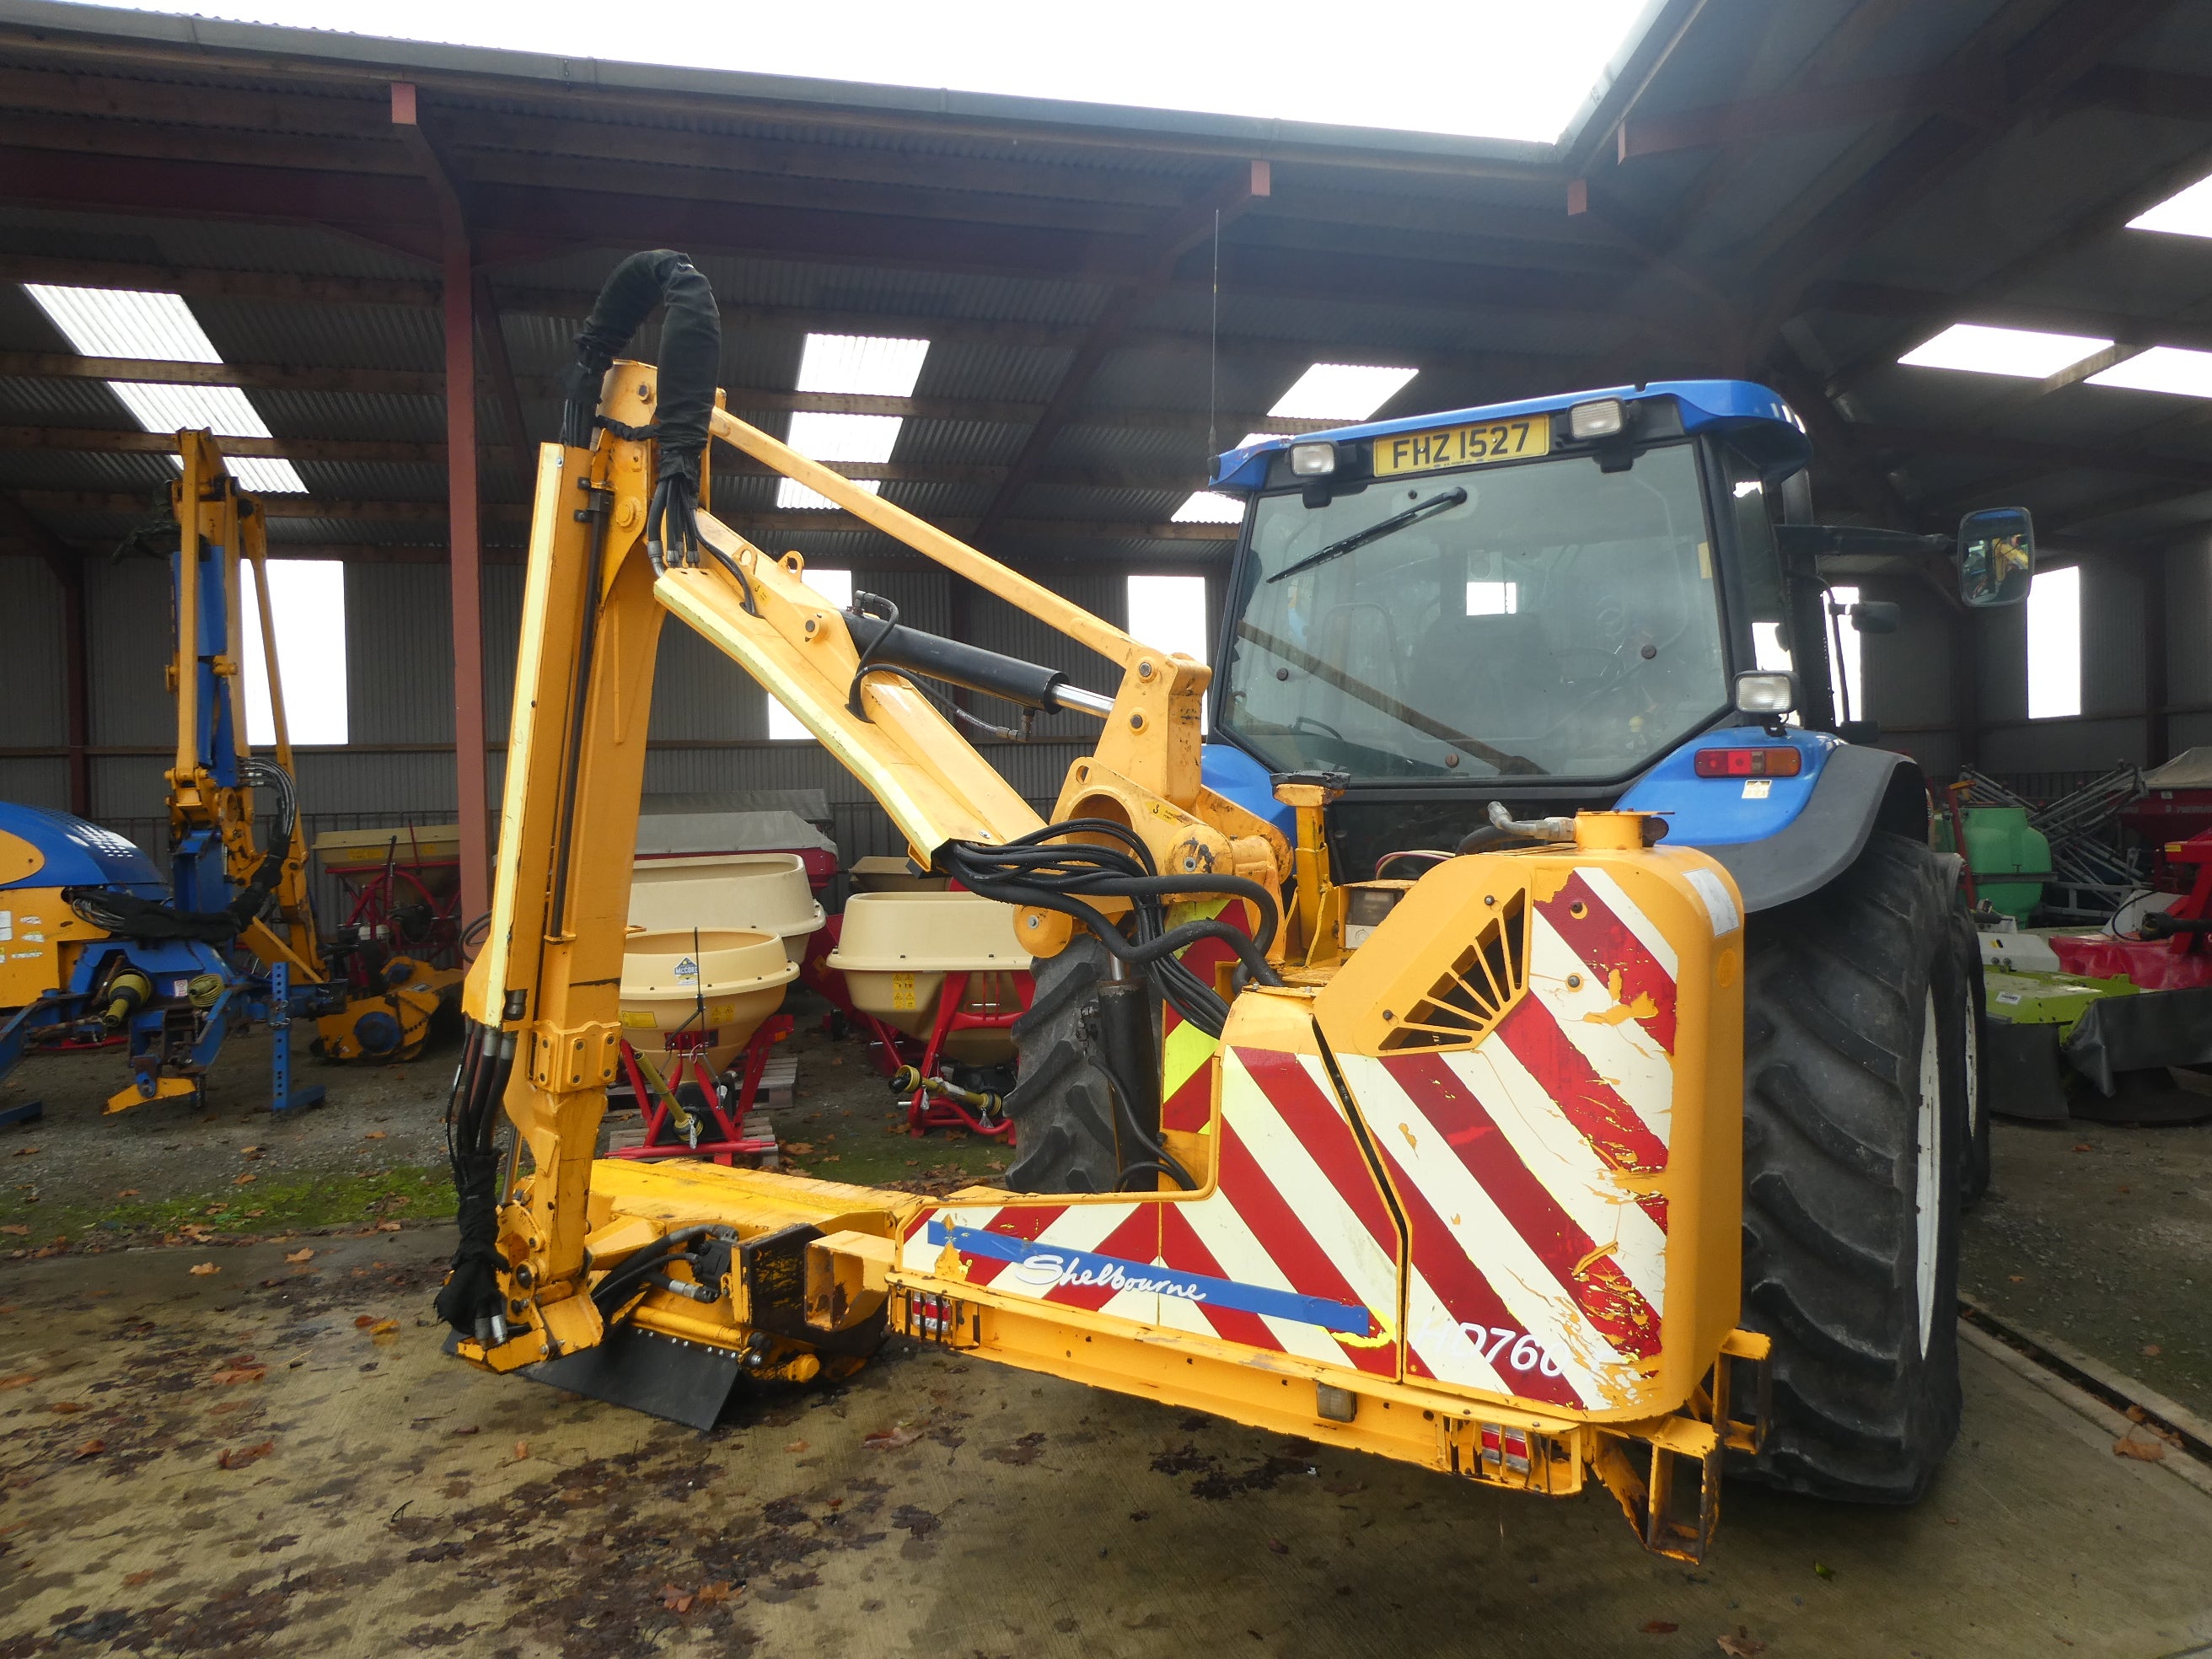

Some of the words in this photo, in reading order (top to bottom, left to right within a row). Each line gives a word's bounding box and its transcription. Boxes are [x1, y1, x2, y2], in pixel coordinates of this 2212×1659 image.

[1393, 432, 1450, 469] FHZ
[1460, 422, 1530, 459] 1527
[1014, 1254, 1206, 1301] Shelbourne
[1414, 1317, 1570, 1377] HD760
